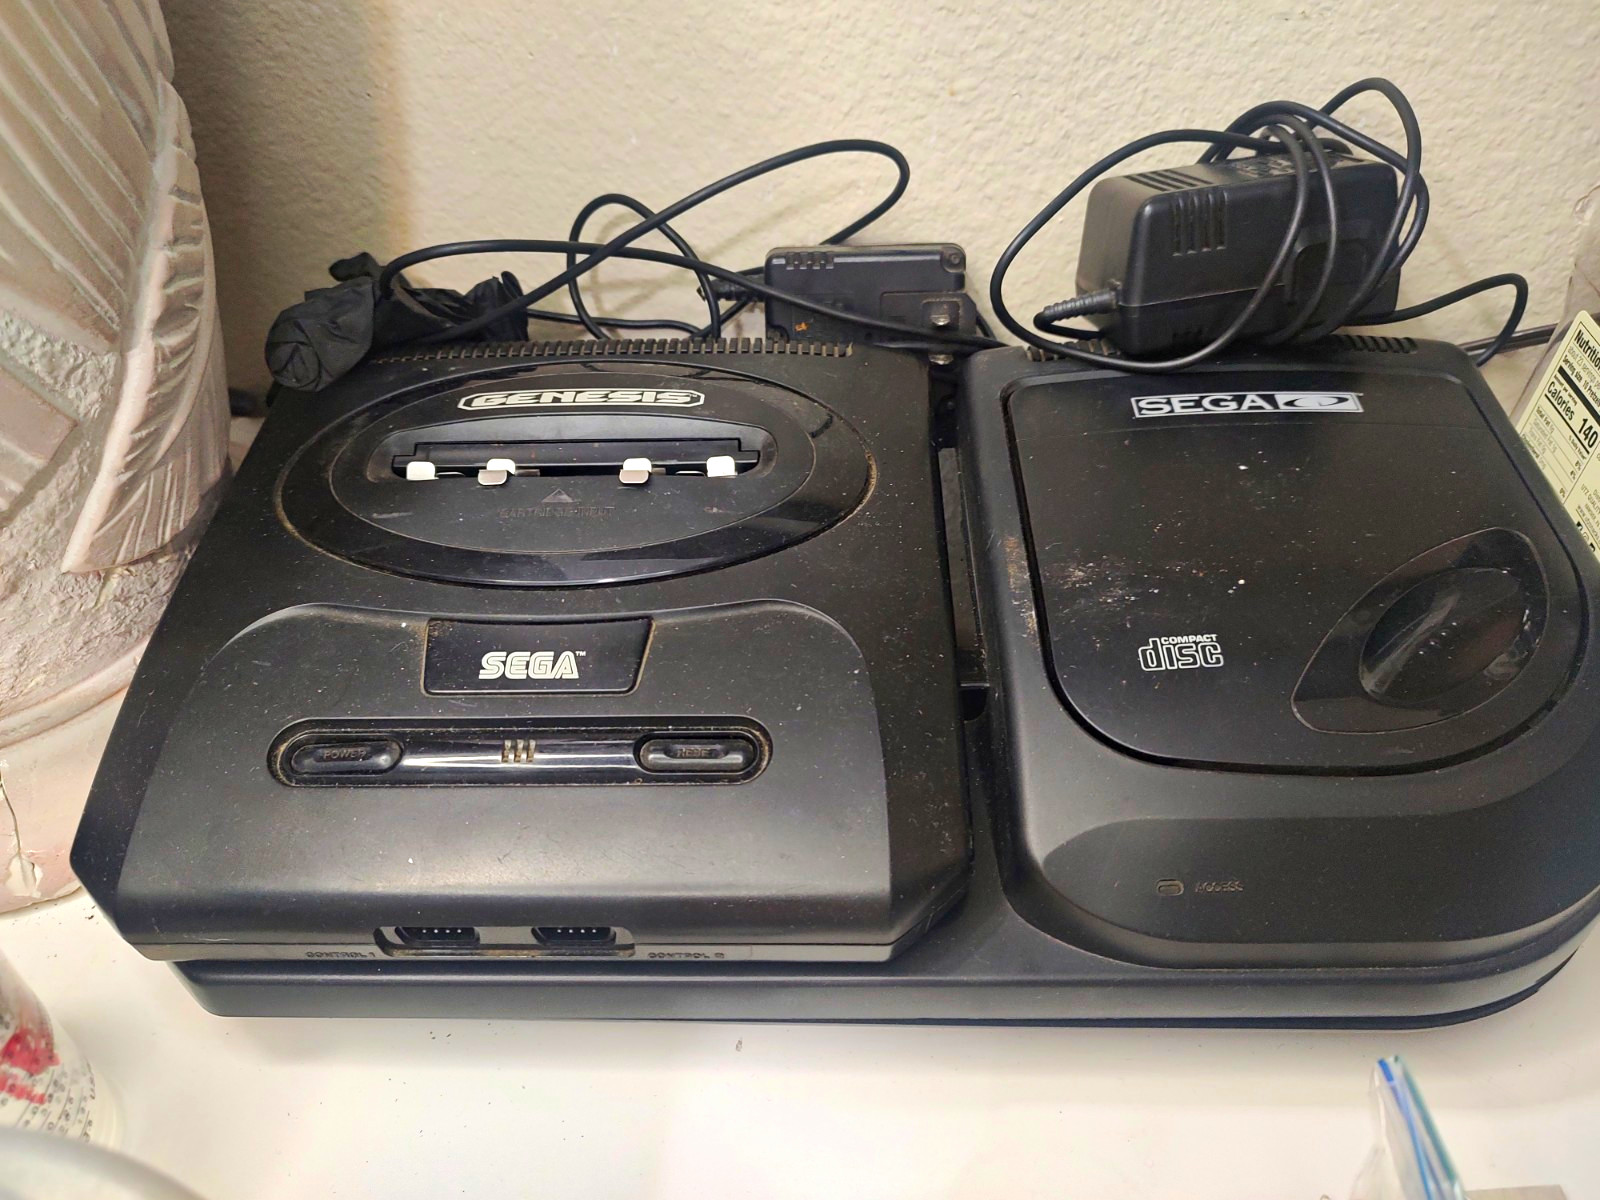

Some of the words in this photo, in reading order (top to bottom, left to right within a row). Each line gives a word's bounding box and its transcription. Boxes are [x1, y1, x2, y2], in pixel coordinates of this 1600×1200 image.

[1563, 355, 1576, 375] Serving
[471, 391, 691, 408] GENESIS
[1137, 394, 1274, 415] SEGA
[1547, 381, 1575, 421] Calories
[1578, 418, 1599, 449] 140
[1161, 634, 1218, 644] COMPACT
[1138, 638, 1224, 671] disc
[479, 651, 579, 679] SEGA
[323, 749, 366, 759] POWER
